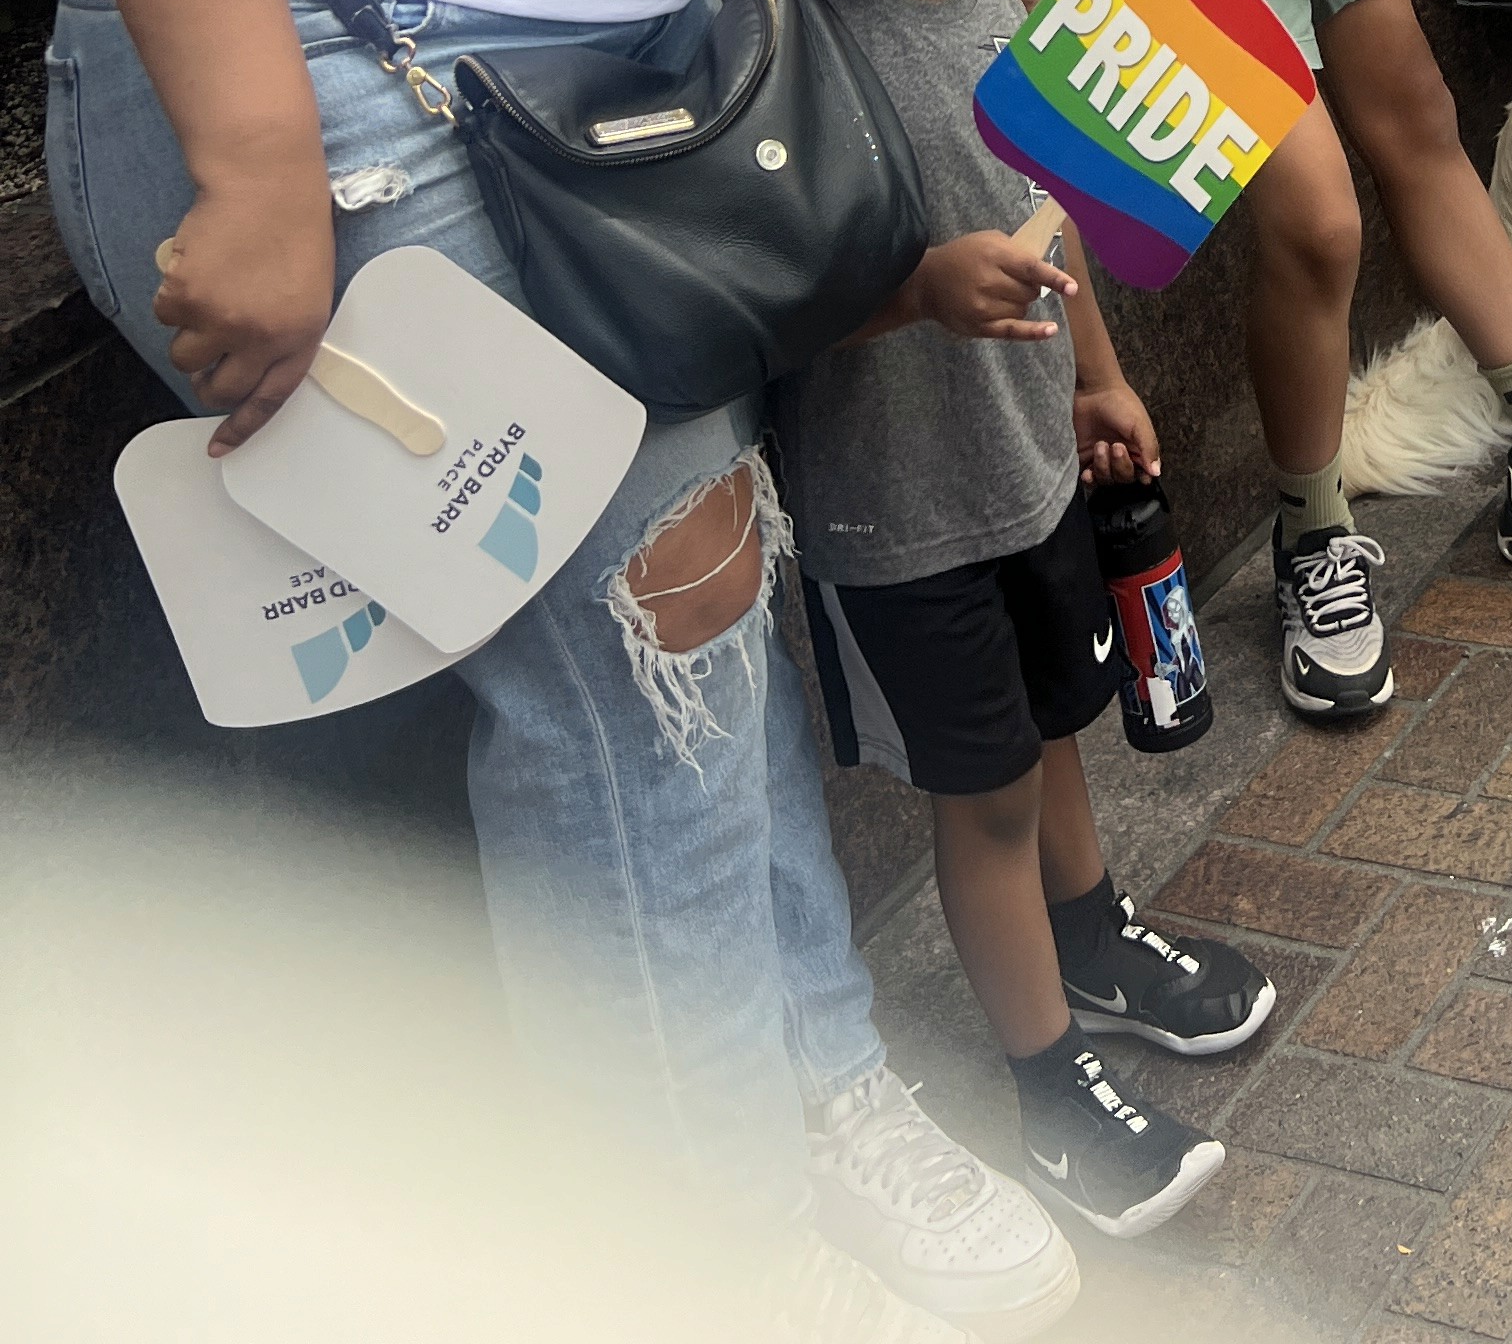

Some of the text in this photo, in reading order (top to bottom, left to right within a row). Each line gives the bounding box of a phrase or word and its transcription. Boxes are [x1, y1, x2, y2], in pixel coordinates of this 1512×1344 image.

[429, 421, 527, 534] BYRD BARR
[437, 438, 484, 492] PLACE
[288, 566, 326, 588] ACE
[261, 586, 327, 621] BARR
